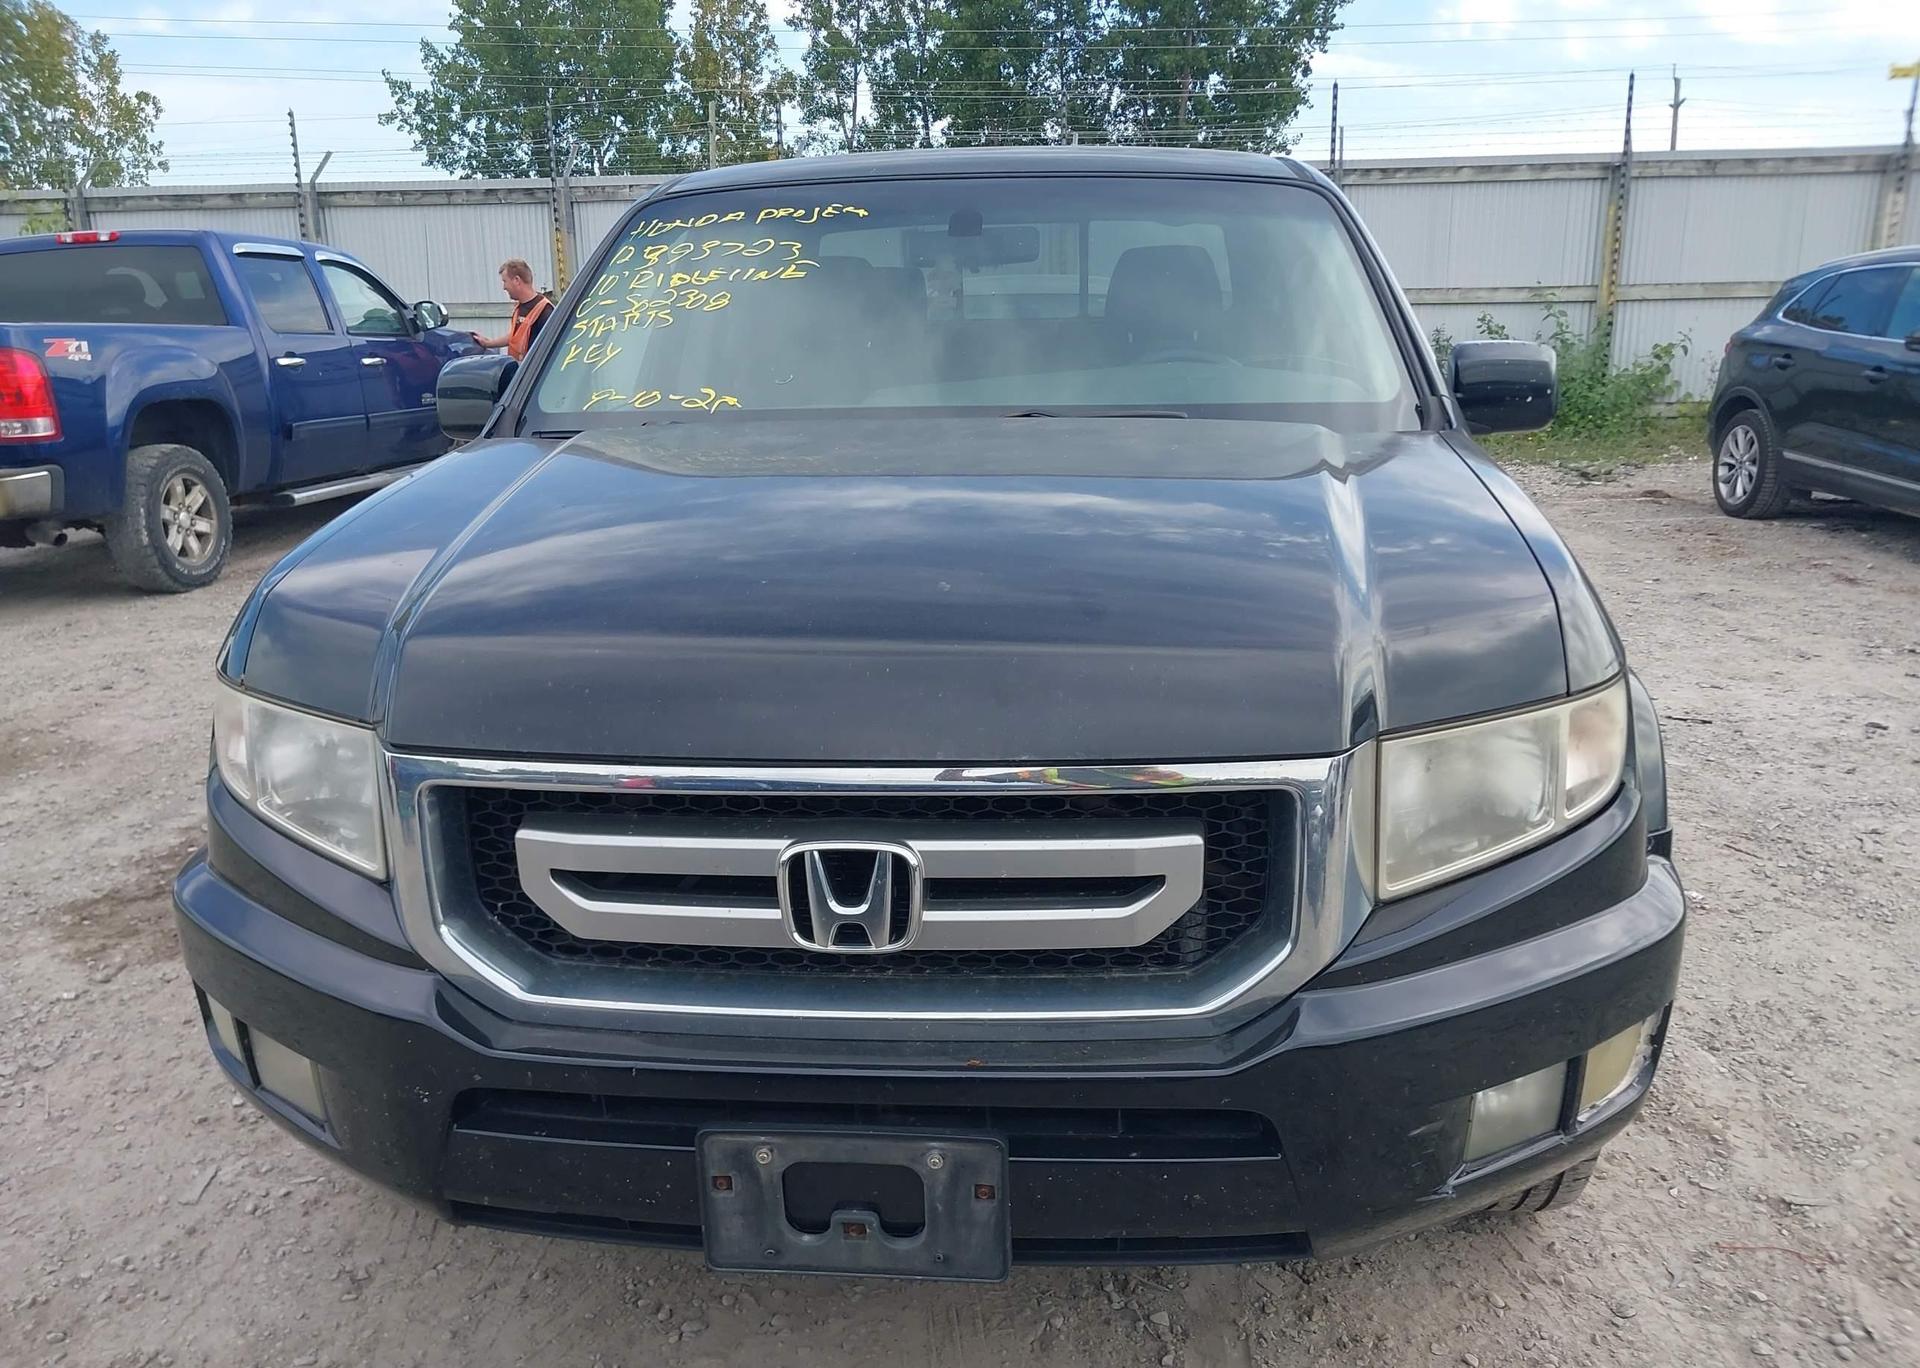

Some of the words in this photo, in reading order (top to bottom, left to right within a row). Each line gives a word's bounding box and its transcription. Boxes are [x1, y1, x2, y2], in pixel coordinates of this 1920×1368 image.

[630, 210, 745, 241] HONDA
[43, 337, 89, 357] Z71
[560, 342, 622, 373] KEY
